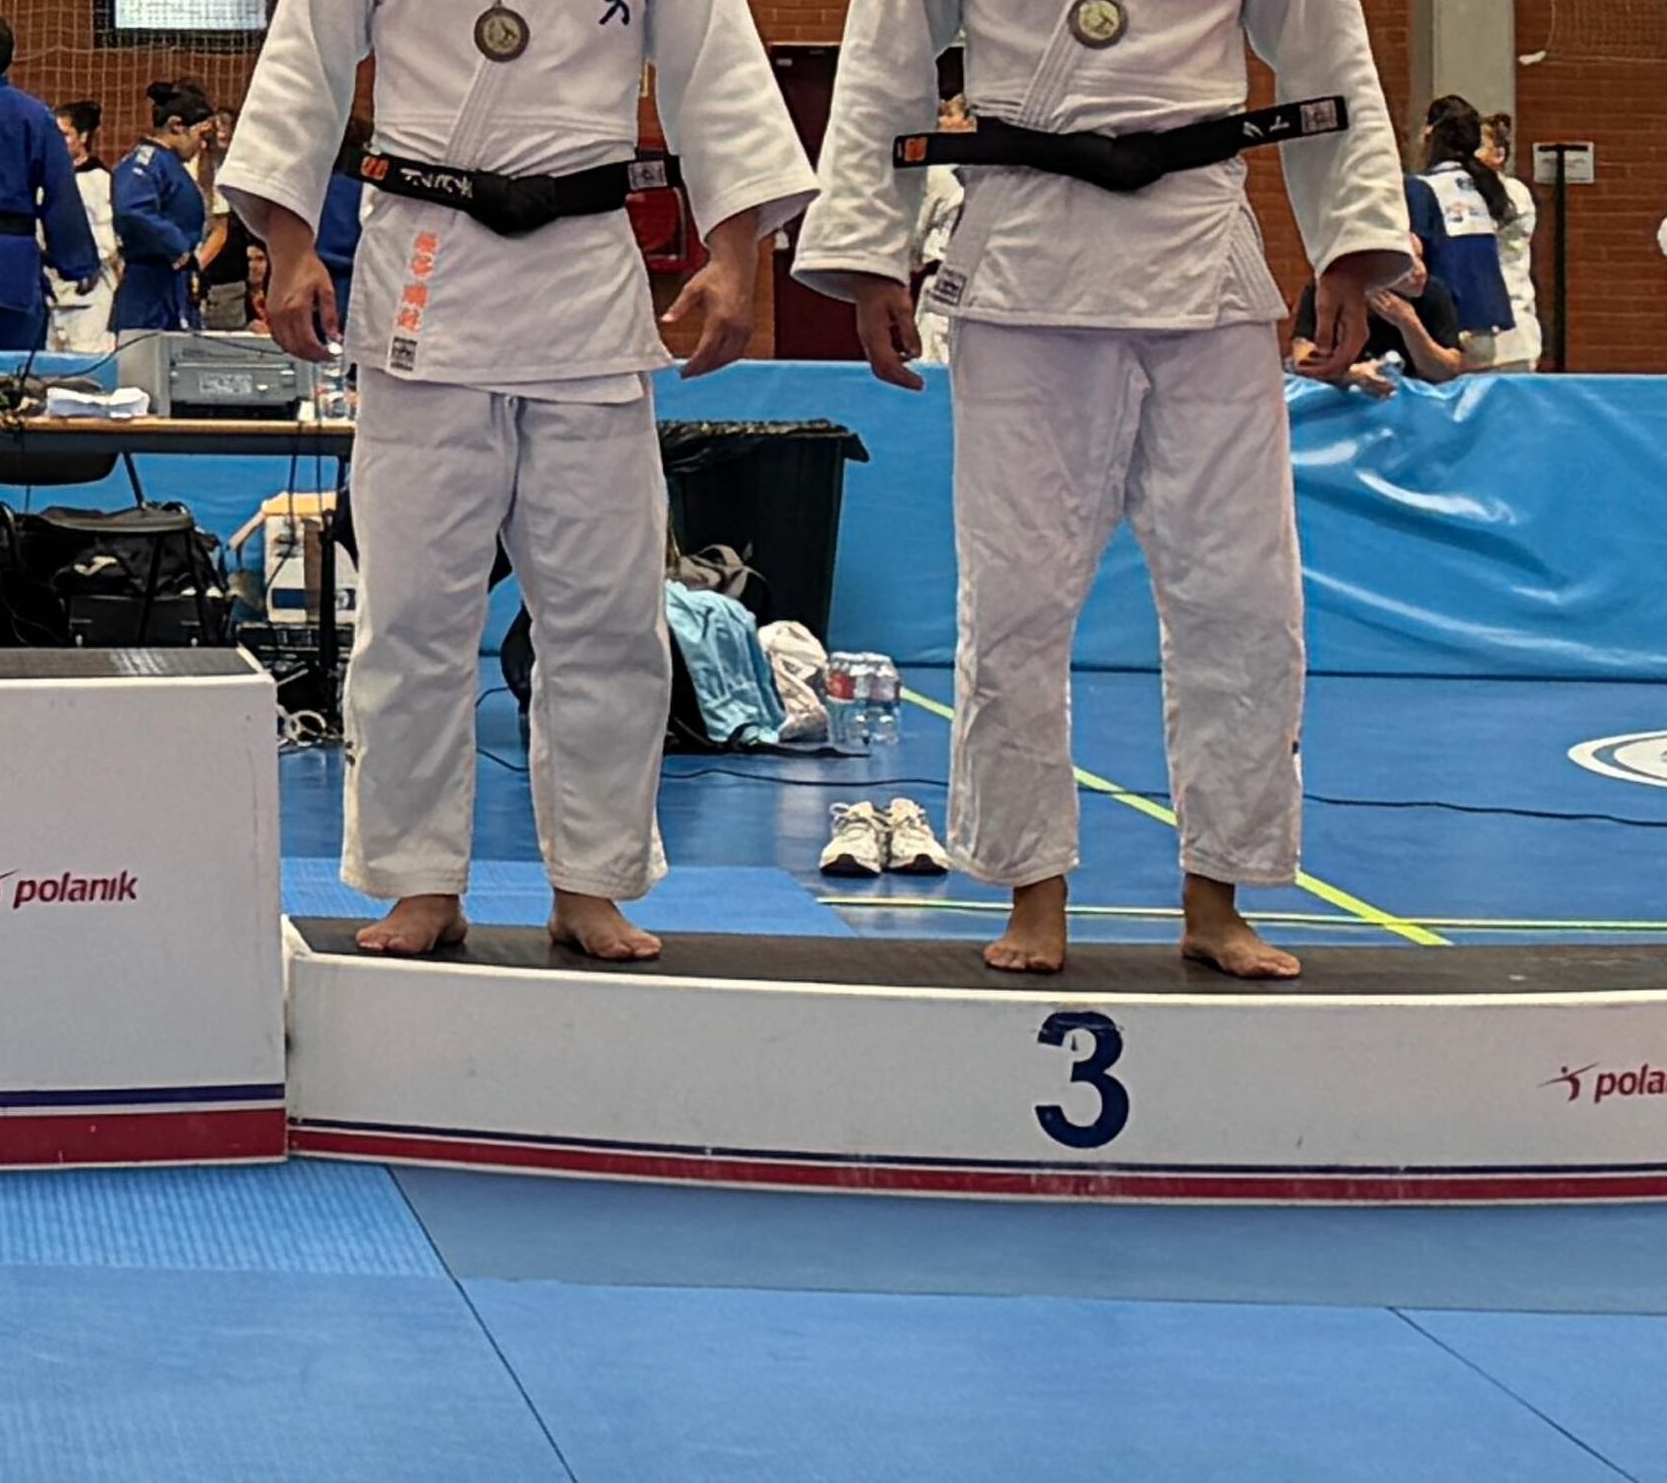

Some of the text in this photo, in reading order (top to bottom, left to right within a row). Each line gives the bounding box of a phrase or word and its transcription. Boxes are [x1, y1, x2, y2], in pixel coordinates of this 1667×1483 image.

[12, 870, 139, 910] polanik
[1035, 1011, 1130, 1149] 3
[1594, 1063, 1667, 1104] pola
